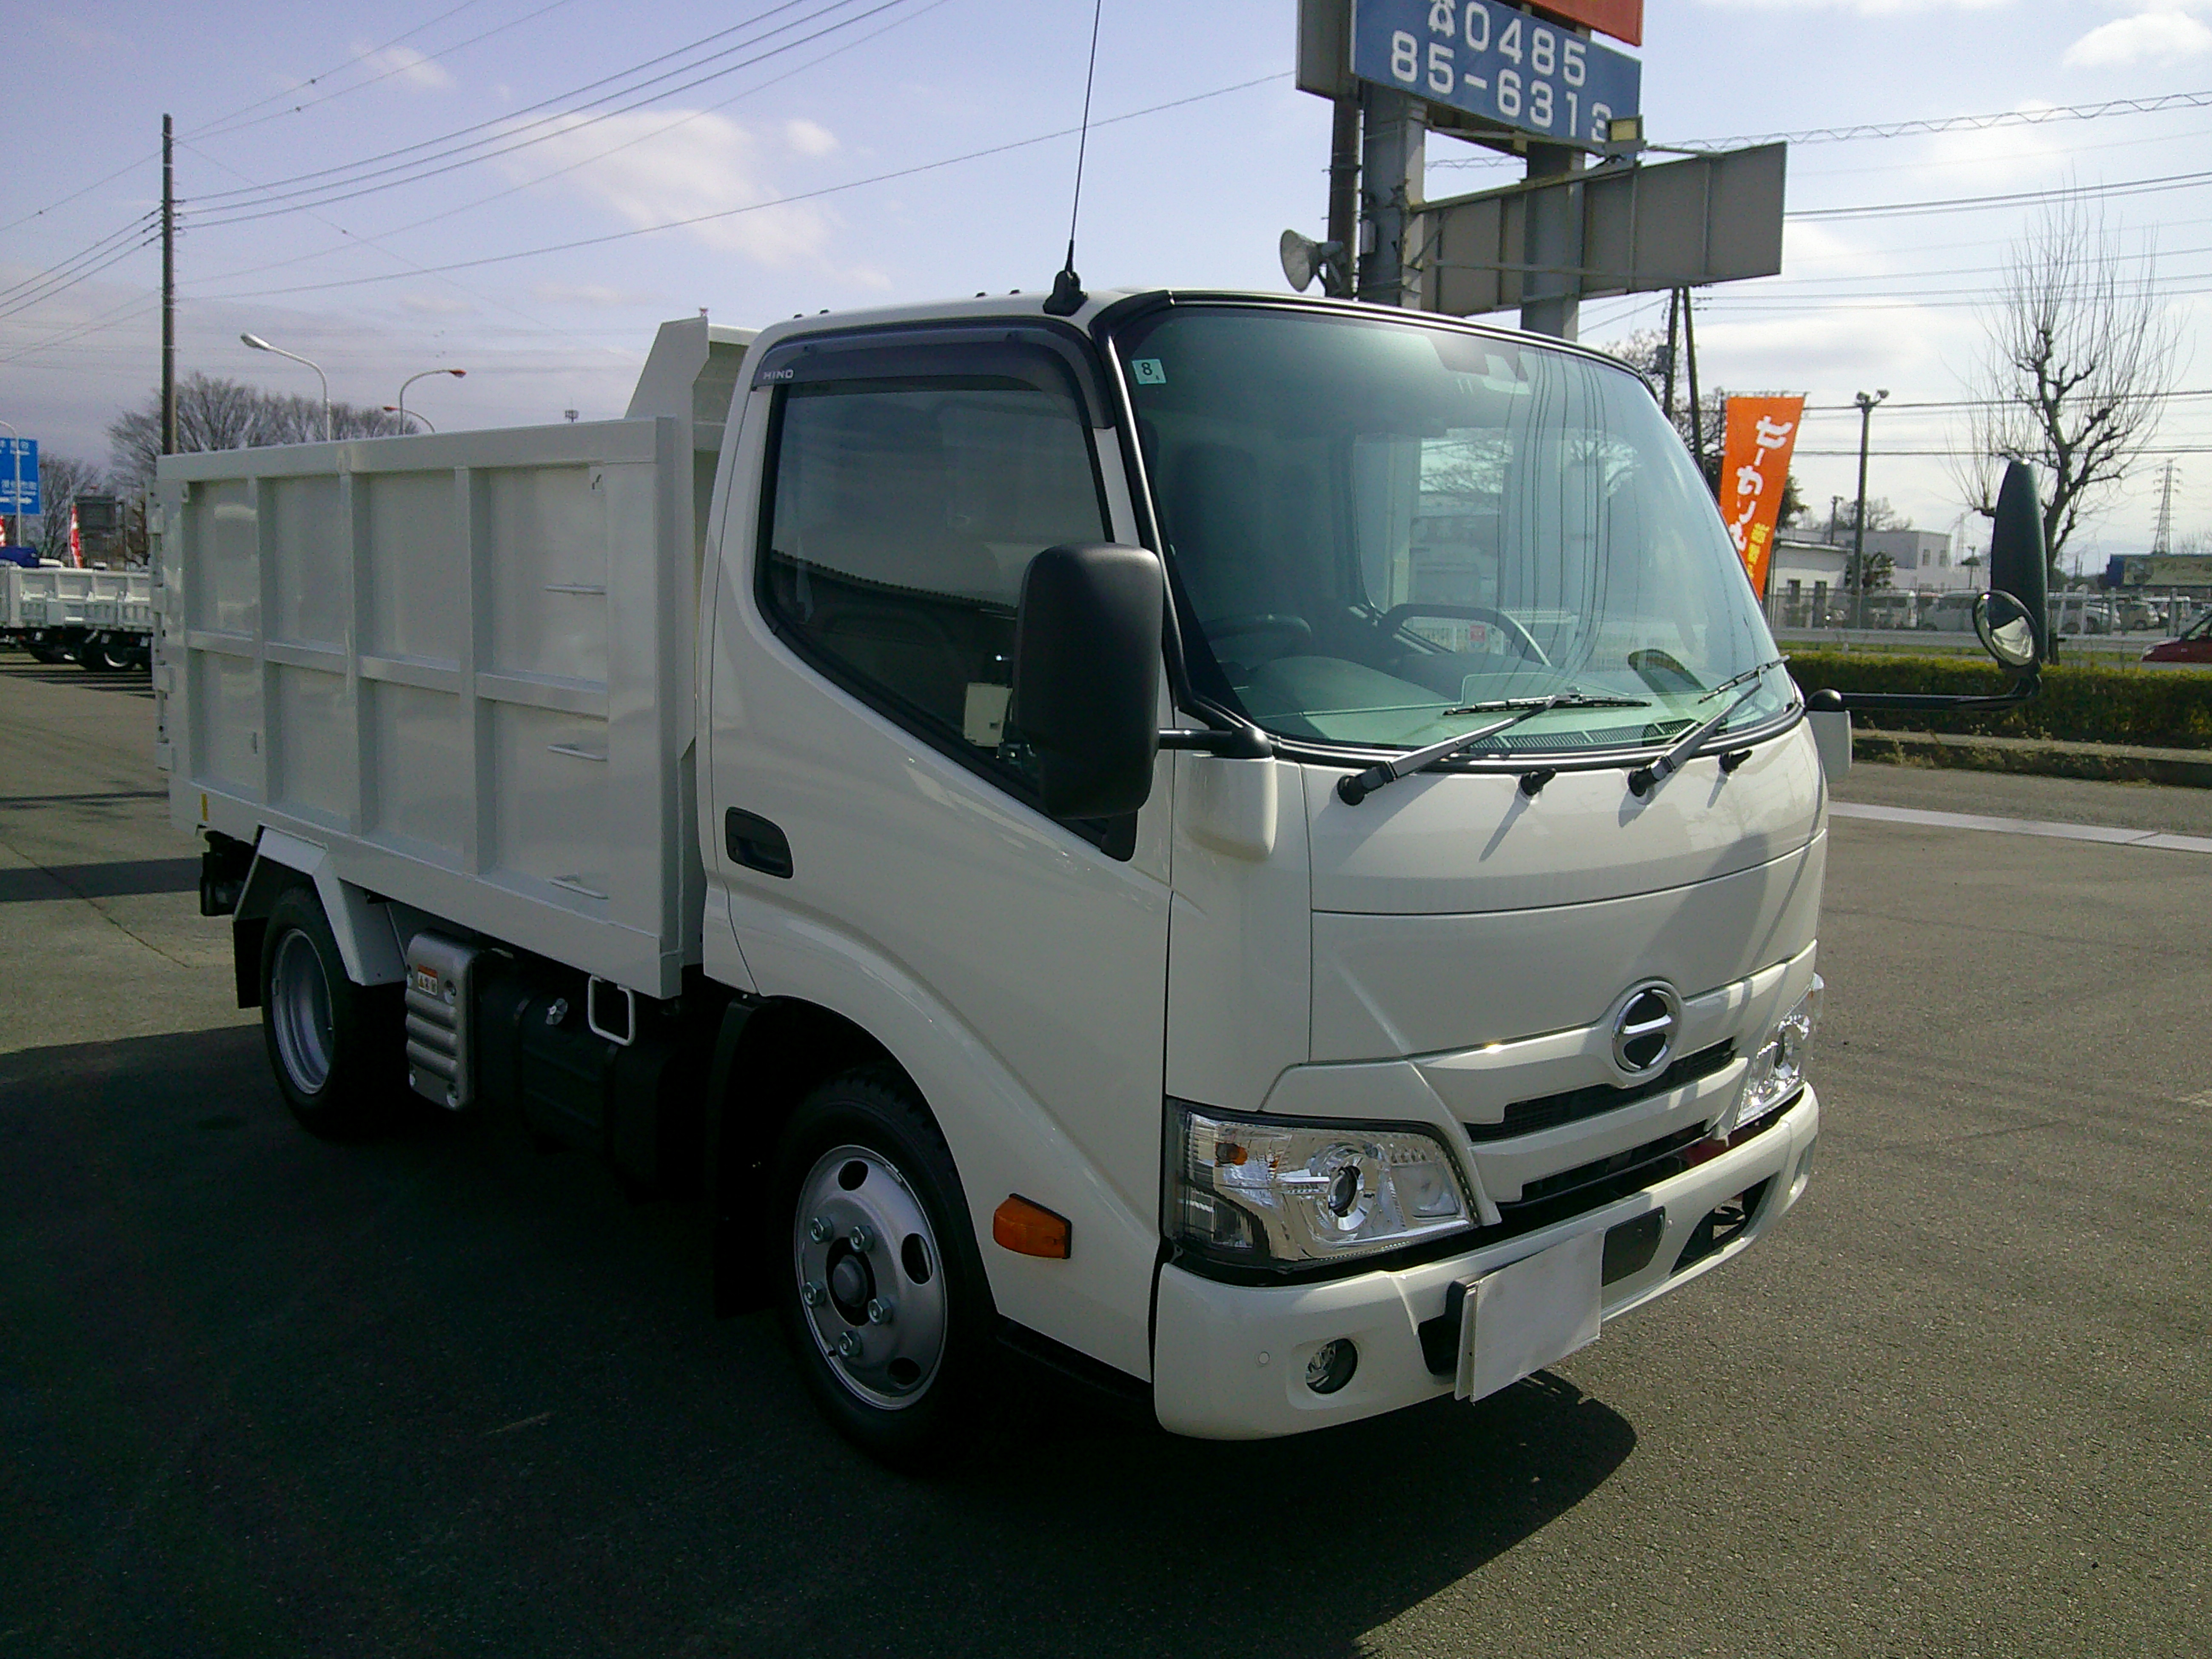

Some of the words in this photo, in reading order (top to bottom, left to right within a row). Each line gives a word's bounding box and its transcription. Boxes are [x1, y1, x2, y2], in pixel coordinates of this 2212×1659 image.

[1391, 30, 1612, 142] 85-6313
[763, 369, 794, 379] HINO
[1141, 362, 1152, 375] 8
